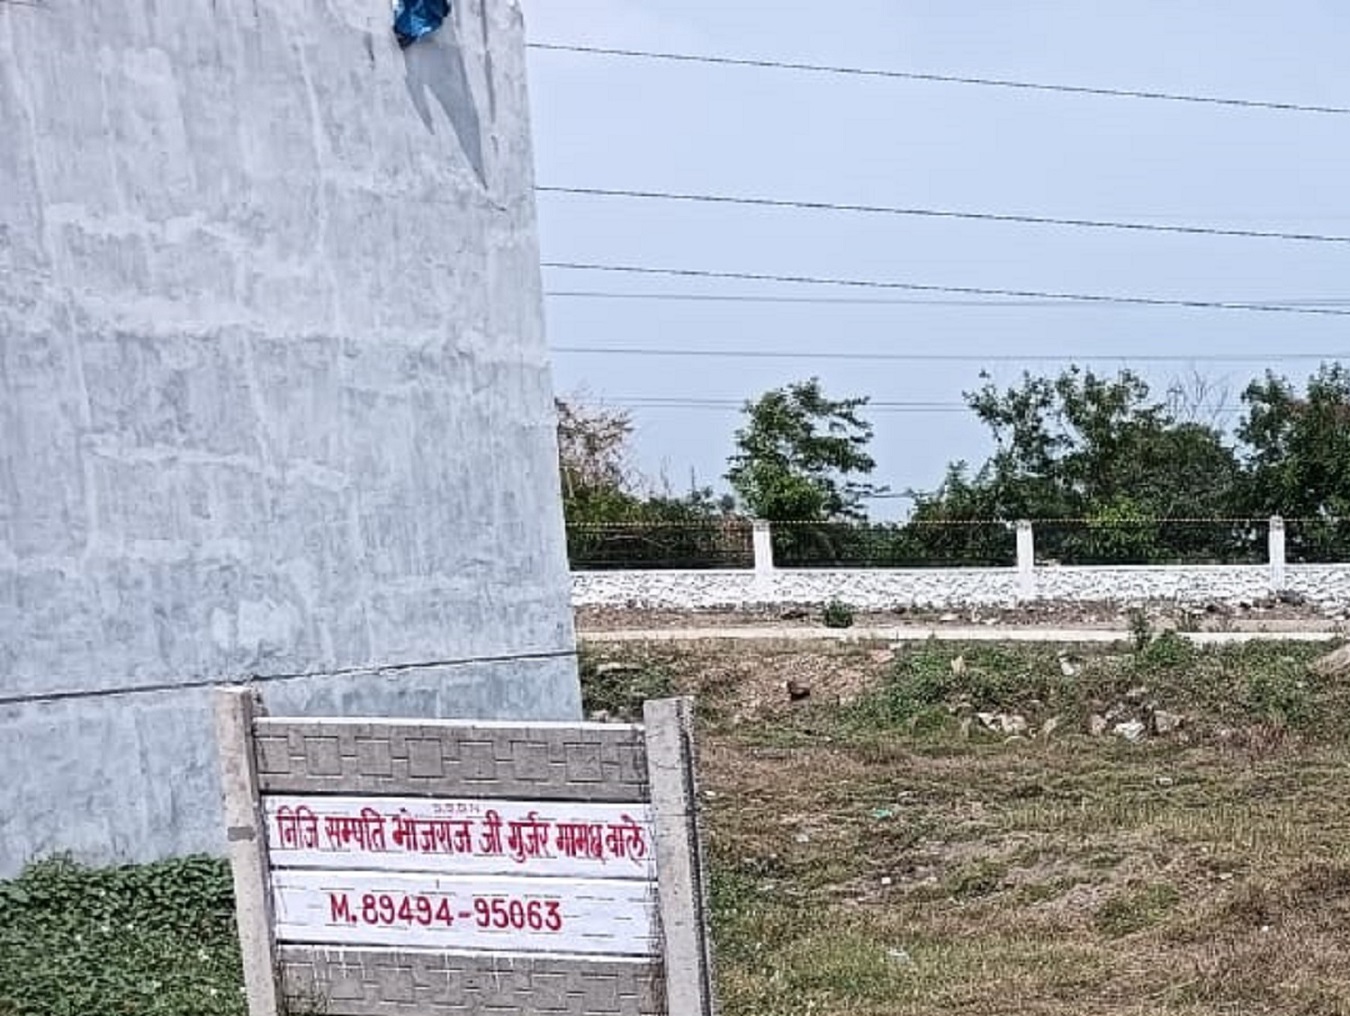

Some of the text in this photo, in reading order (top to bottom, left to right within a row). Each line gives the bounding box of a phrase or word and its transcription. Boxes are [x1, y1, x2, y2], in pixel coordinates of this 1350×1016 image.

[276, 804, 318, 849] निजि
[479, 808, 503, 853] जी
[508, 810, 551, 864] गुर्जर
[606, 808, 647, 866] वाले
